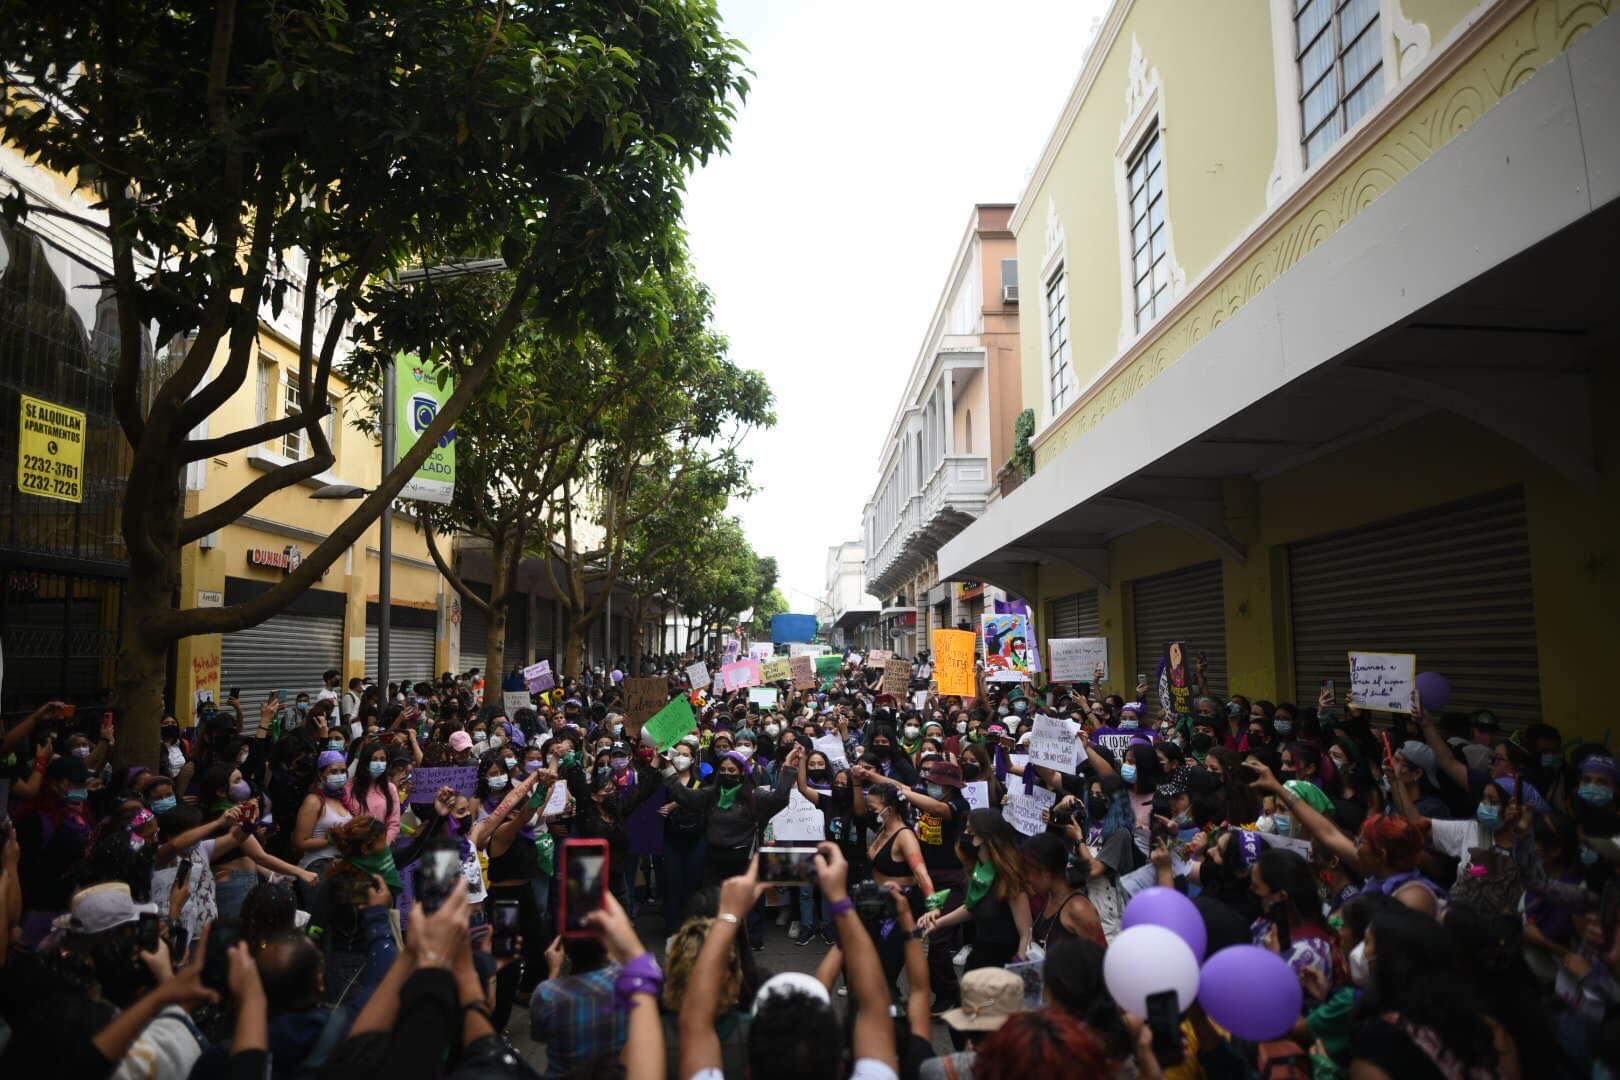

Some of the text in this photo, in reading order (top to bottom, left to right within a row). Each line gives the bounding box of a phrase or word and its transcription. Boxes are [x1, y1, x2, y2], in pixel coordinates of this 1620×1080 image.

[26, 403, 81, 430] SE ALQUILAN
[24, 419, 81, 443] APARTAMENTOS
[24, 454, 79, 480] 2232-3761
[23, 473, 79, 497] 2232-7226
